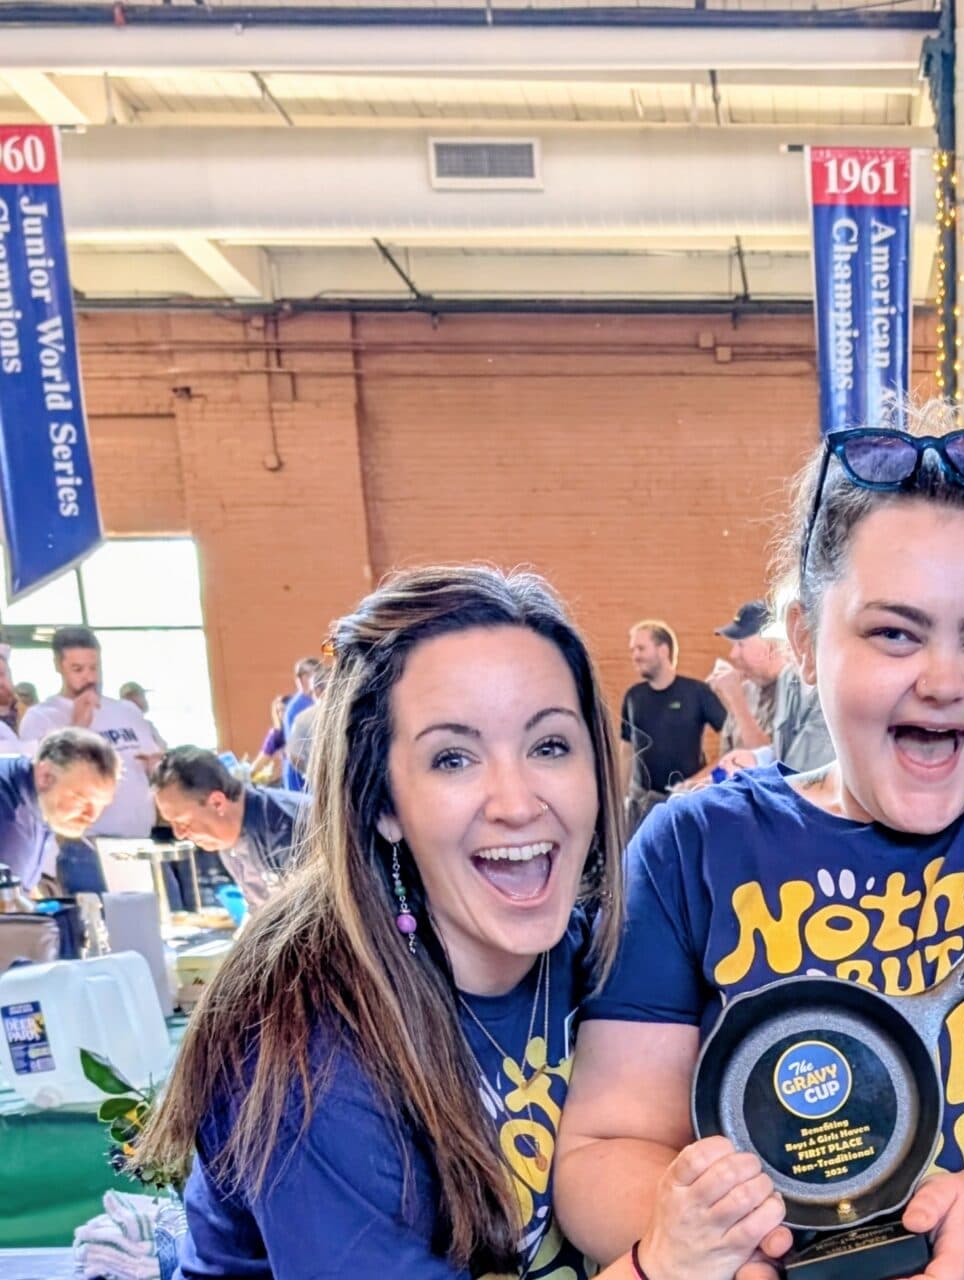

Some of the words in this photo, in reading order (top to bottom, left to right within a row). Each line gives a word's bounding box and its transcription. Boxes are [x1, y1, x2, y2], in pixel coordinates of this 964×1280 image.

[0, 135, 46, 173] 60
[824, 157, 897, 195] 1961
[19, 196, 55, 304] Junior
[832, 217, 859, 391] Champions
[870, 216, 897, 369] American
[36, 316, 73, 412] World
[49, 421, 83, 518] Series
[781, 1063, 838, 1095] GRAVY
[788, 1059, 814, 1075] The
[804, 1080, 841, 1104] CUP
[784, 1141, 808, 1153] Boys
[817, 1132, 839, 1145] Girls
[839, 1125, 871, 1139] Haven
[801, 1119, 849, 1137] Benefiting
[792, 1146, 875, 1176] Non-Traditional
[797, 1146, 828, 1161] FIRST
[828, 1136, 864, 1153] PLACE
